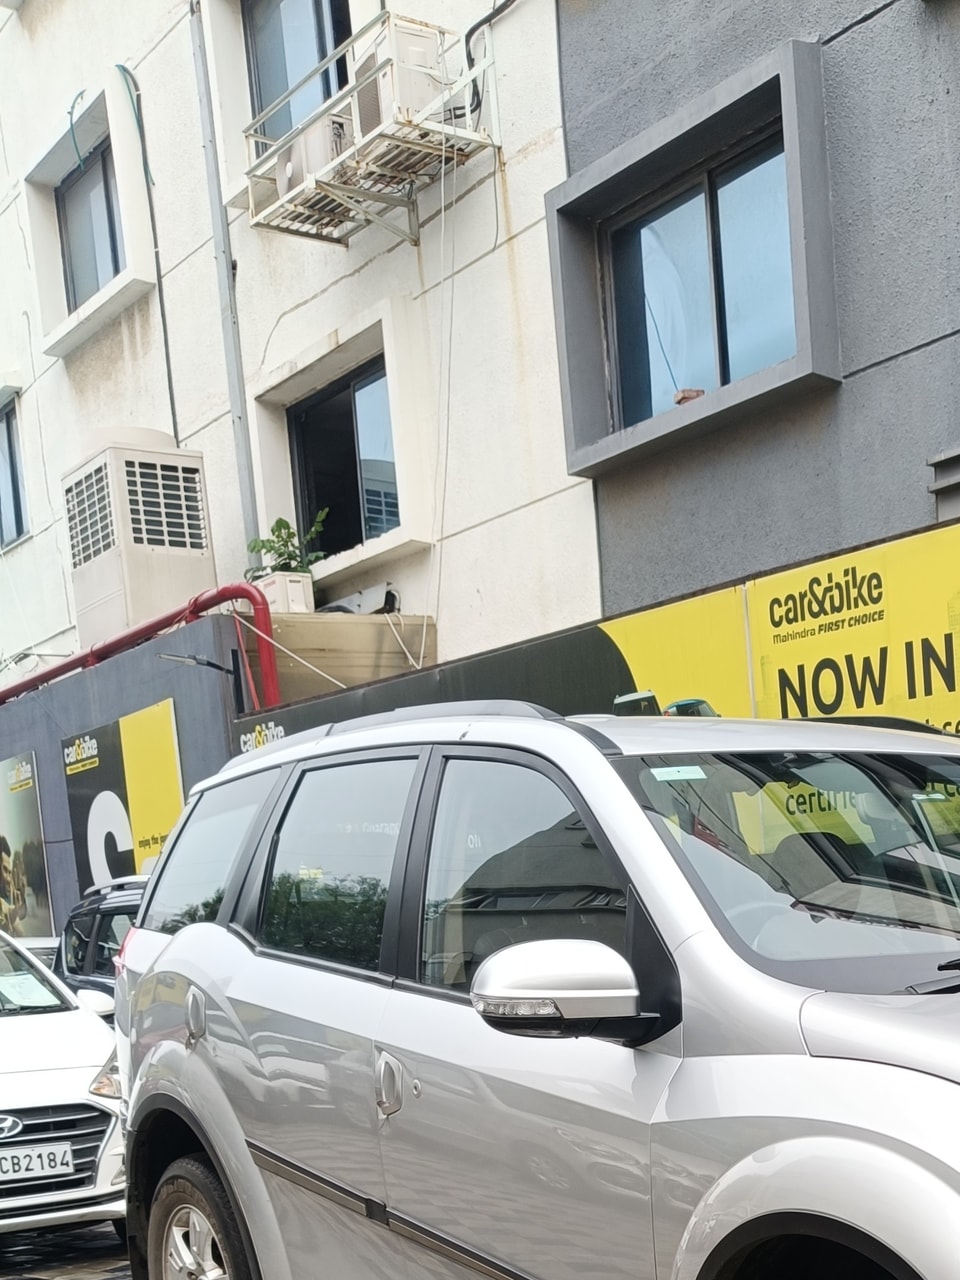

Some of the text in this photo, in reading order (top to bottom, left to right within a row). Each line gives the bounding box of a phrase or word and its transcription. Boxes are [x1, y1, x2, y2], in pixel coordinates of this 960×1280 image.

[769, 566, 883, 628] car&bike
[773, 609, 885, 645] Mahindra FIRST CHOICE
[778, 646, 888, 719] NOW
[905, 632, 956, 700] IN
[64, 735, 98, 764] car&bike
[240, 721, 285, 752] car&bike
[0, 1150, 70, 1174] CB2184
